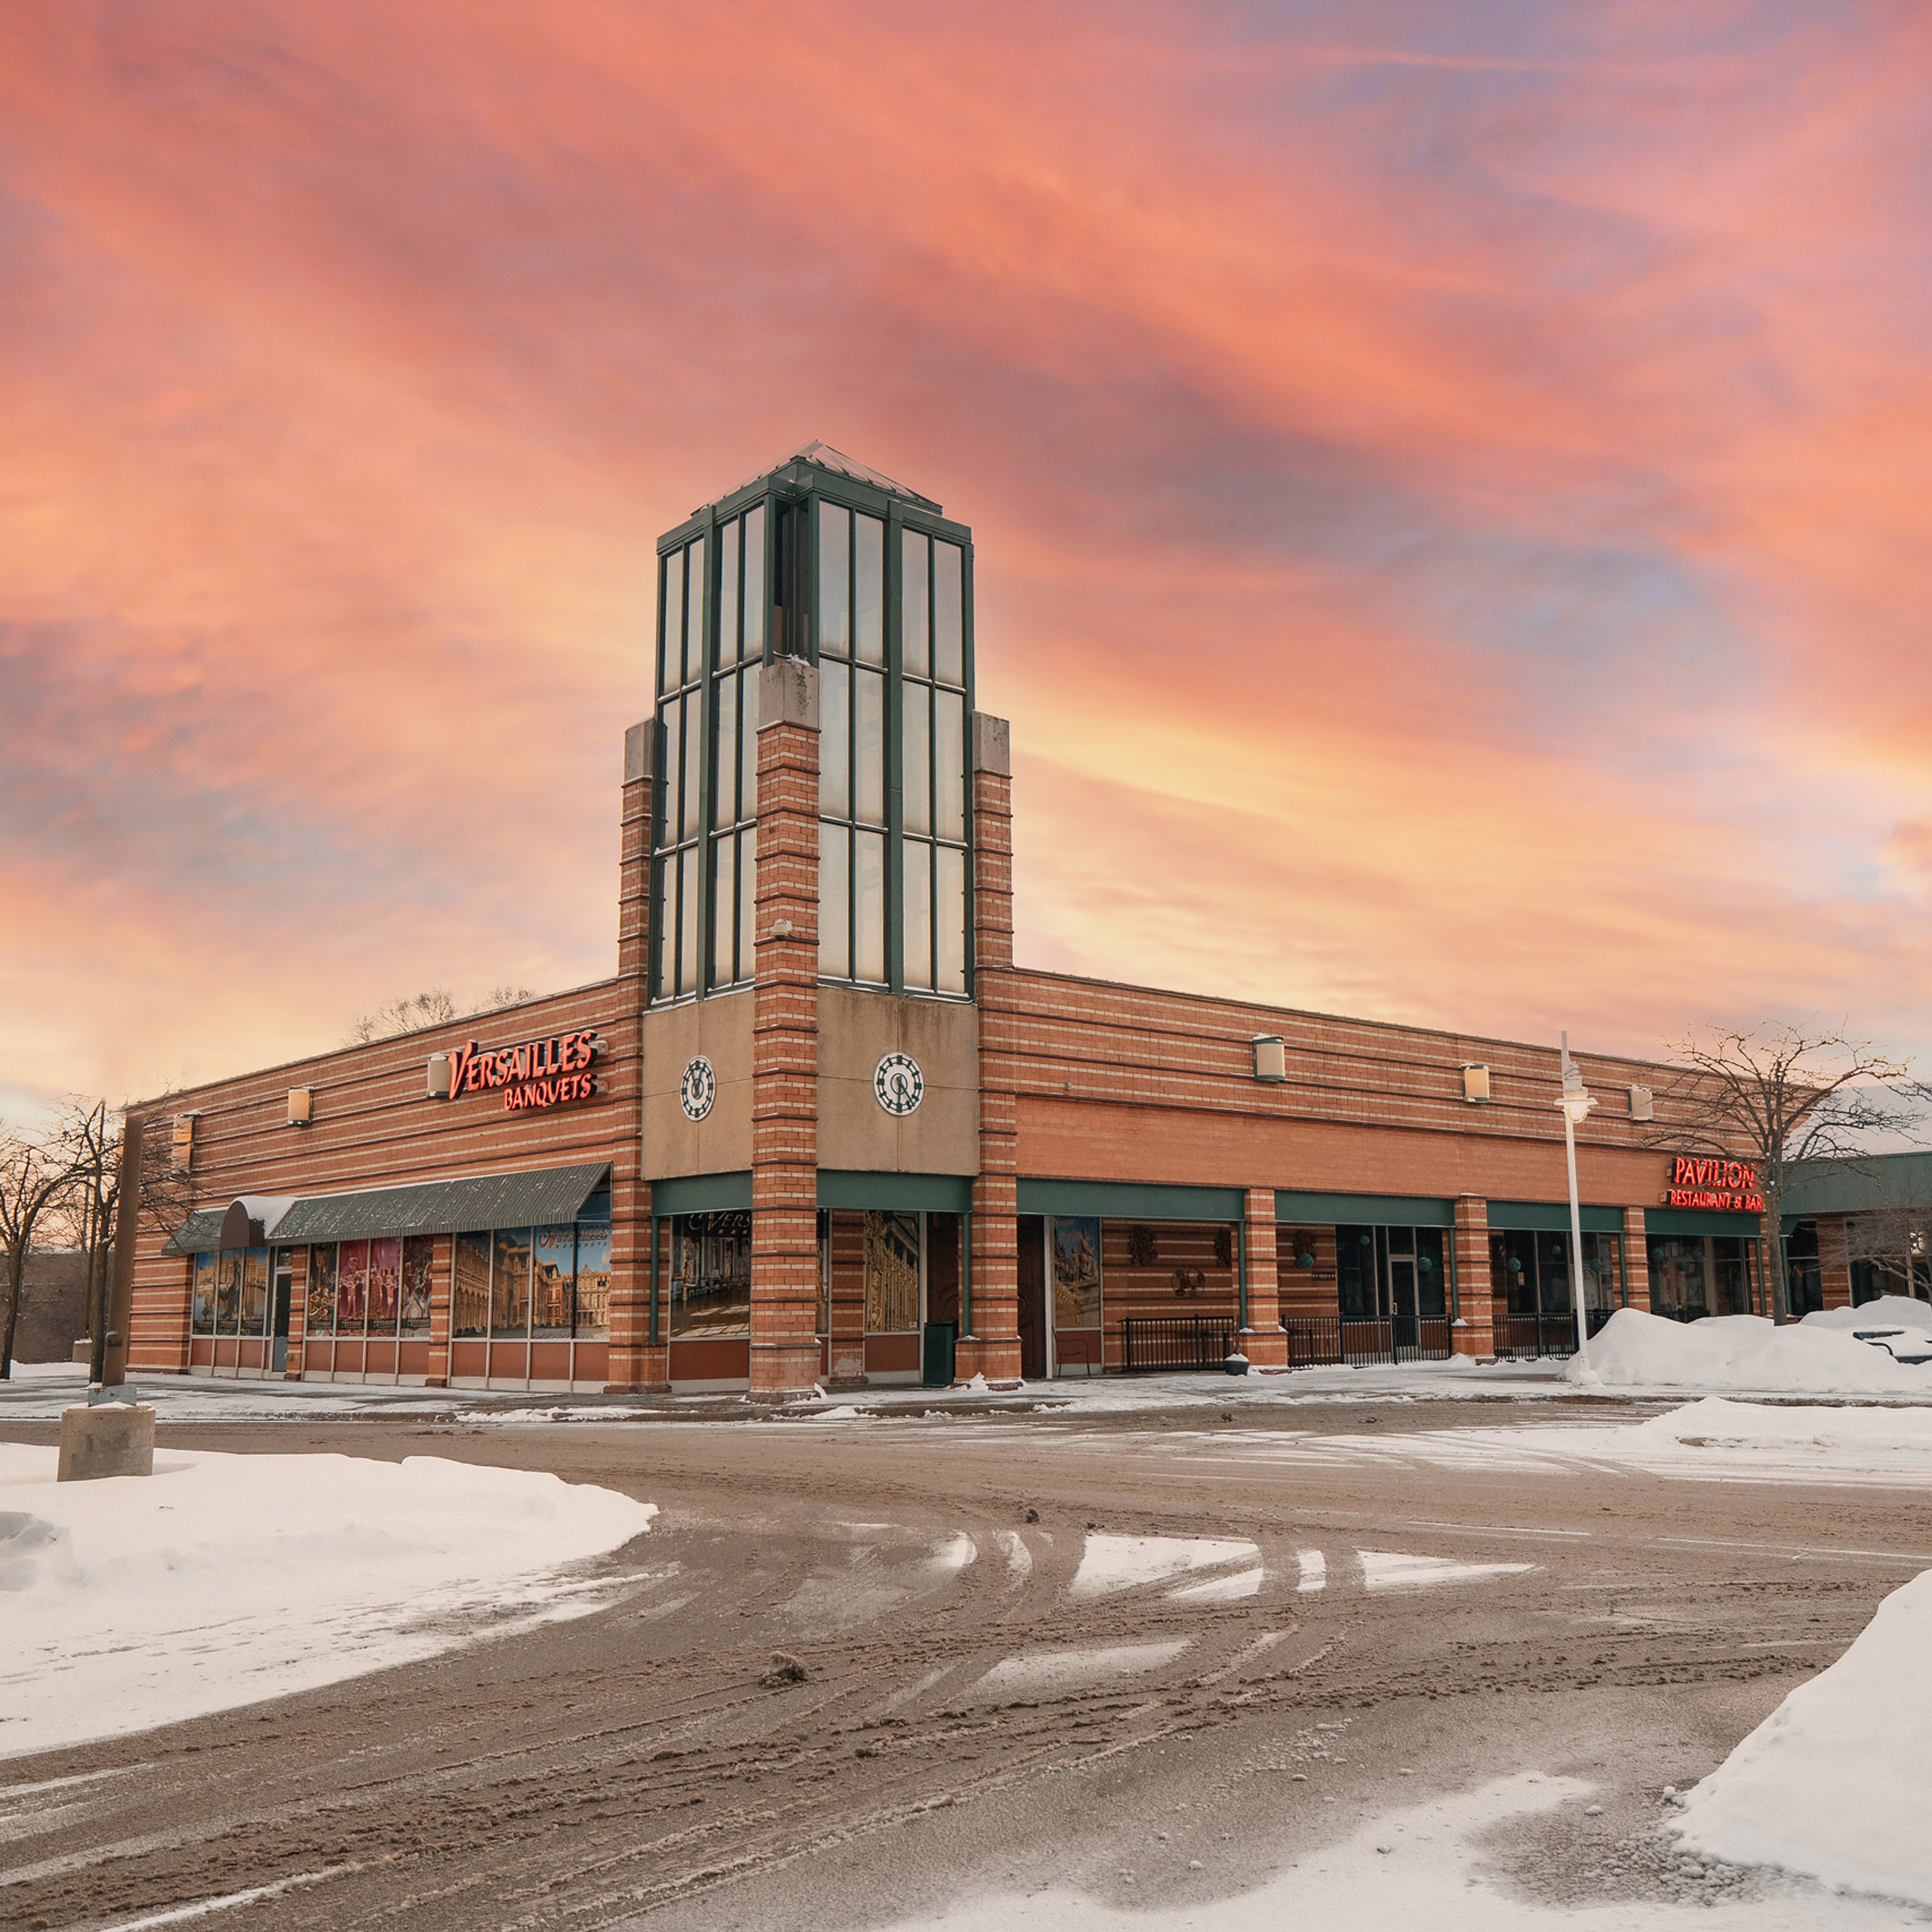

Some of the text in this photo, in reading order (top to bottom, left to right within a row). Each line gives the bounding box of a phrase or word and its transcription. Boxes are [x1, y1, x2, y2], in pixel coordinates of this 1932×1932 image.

[448, 1031, 595, 1100] VERSAILLES
[503, 1073, 594, 1111] BANQUETS
[1674, 1157, 1755, 1189] PAVILION
[1670, 1189, 1763, 1210] RESTAURANT & BAR
